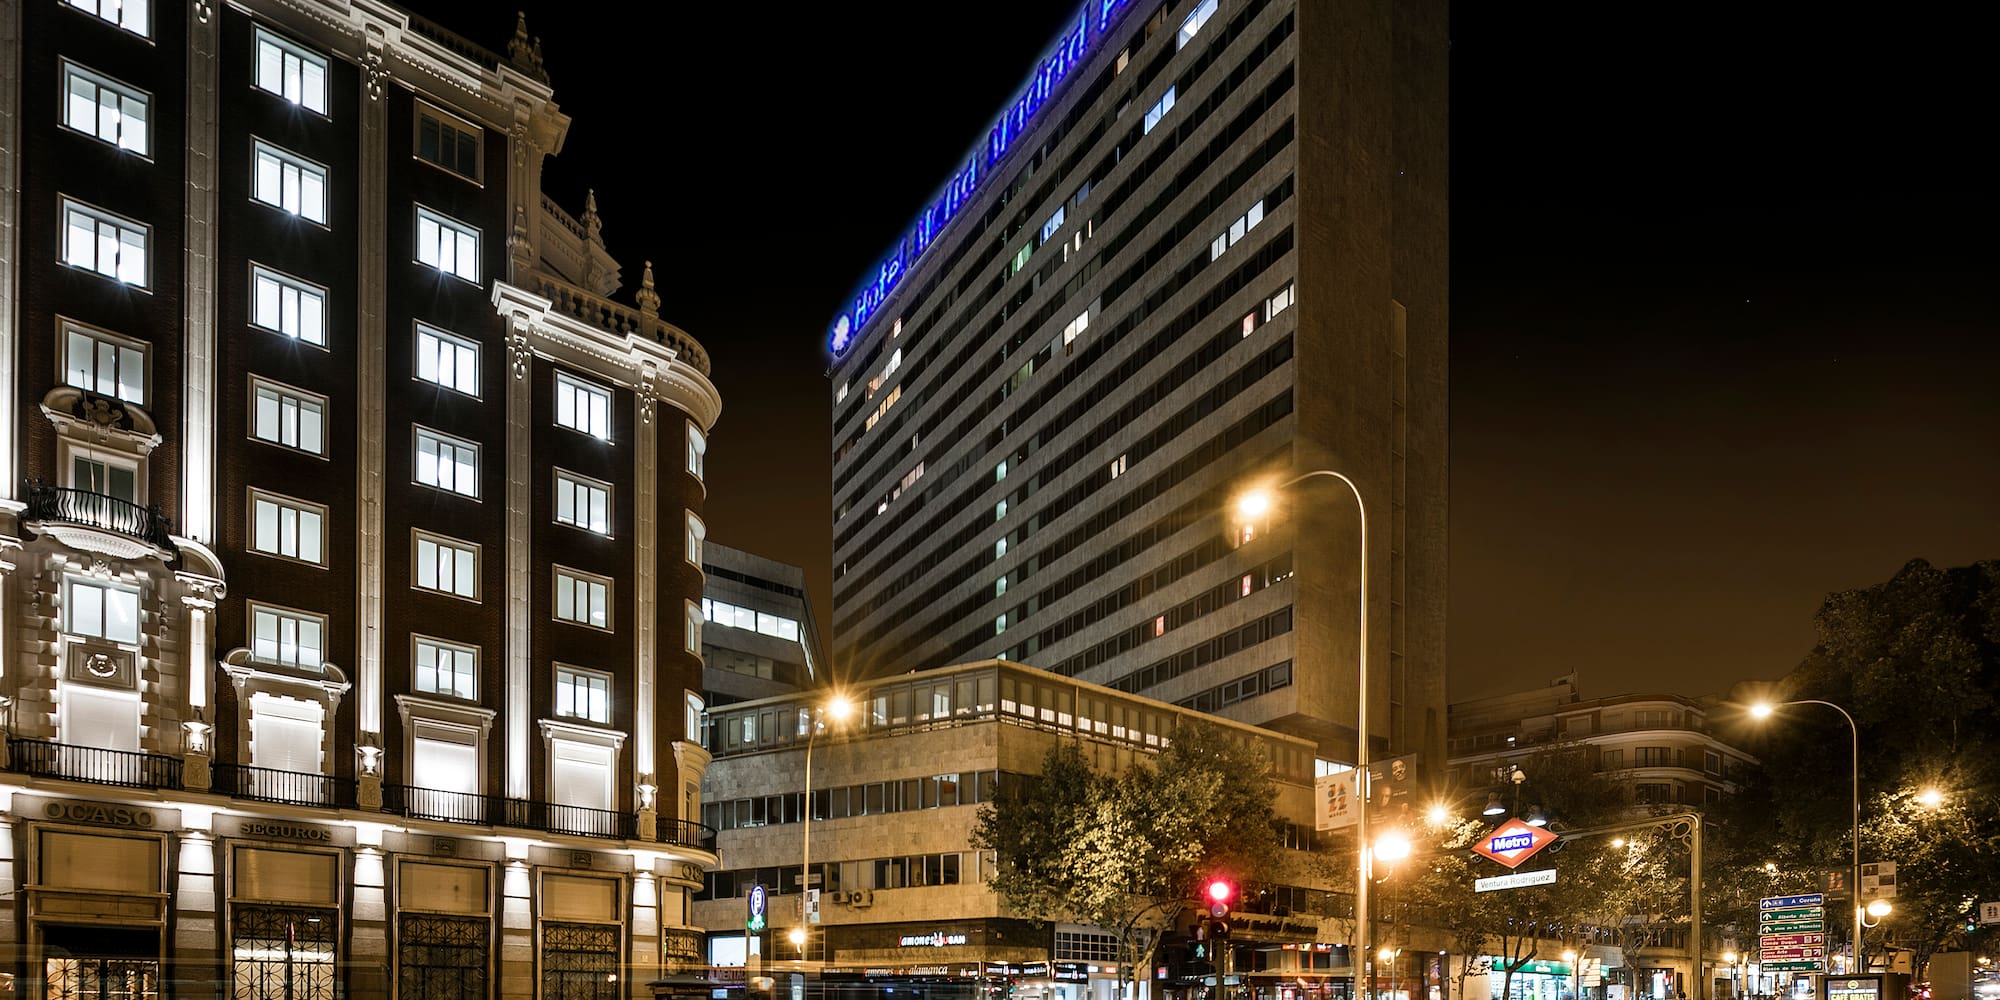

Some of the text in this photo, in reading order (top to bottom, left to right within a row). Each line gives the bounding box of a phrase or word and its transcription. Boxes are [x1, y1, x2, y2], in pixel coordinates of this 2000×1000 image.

[852, 237, 909, 331] Hotel
[988, 8, 1090, 164] Madrid
[43, 800, 157, 828] OCASO
[240, 821, 332, 841] SEGUROS
[1494, 837, 1530, 851] Metro
[1480, 880, 1508, 889] Ventura
[897, 935, 934, 947] Jamones
